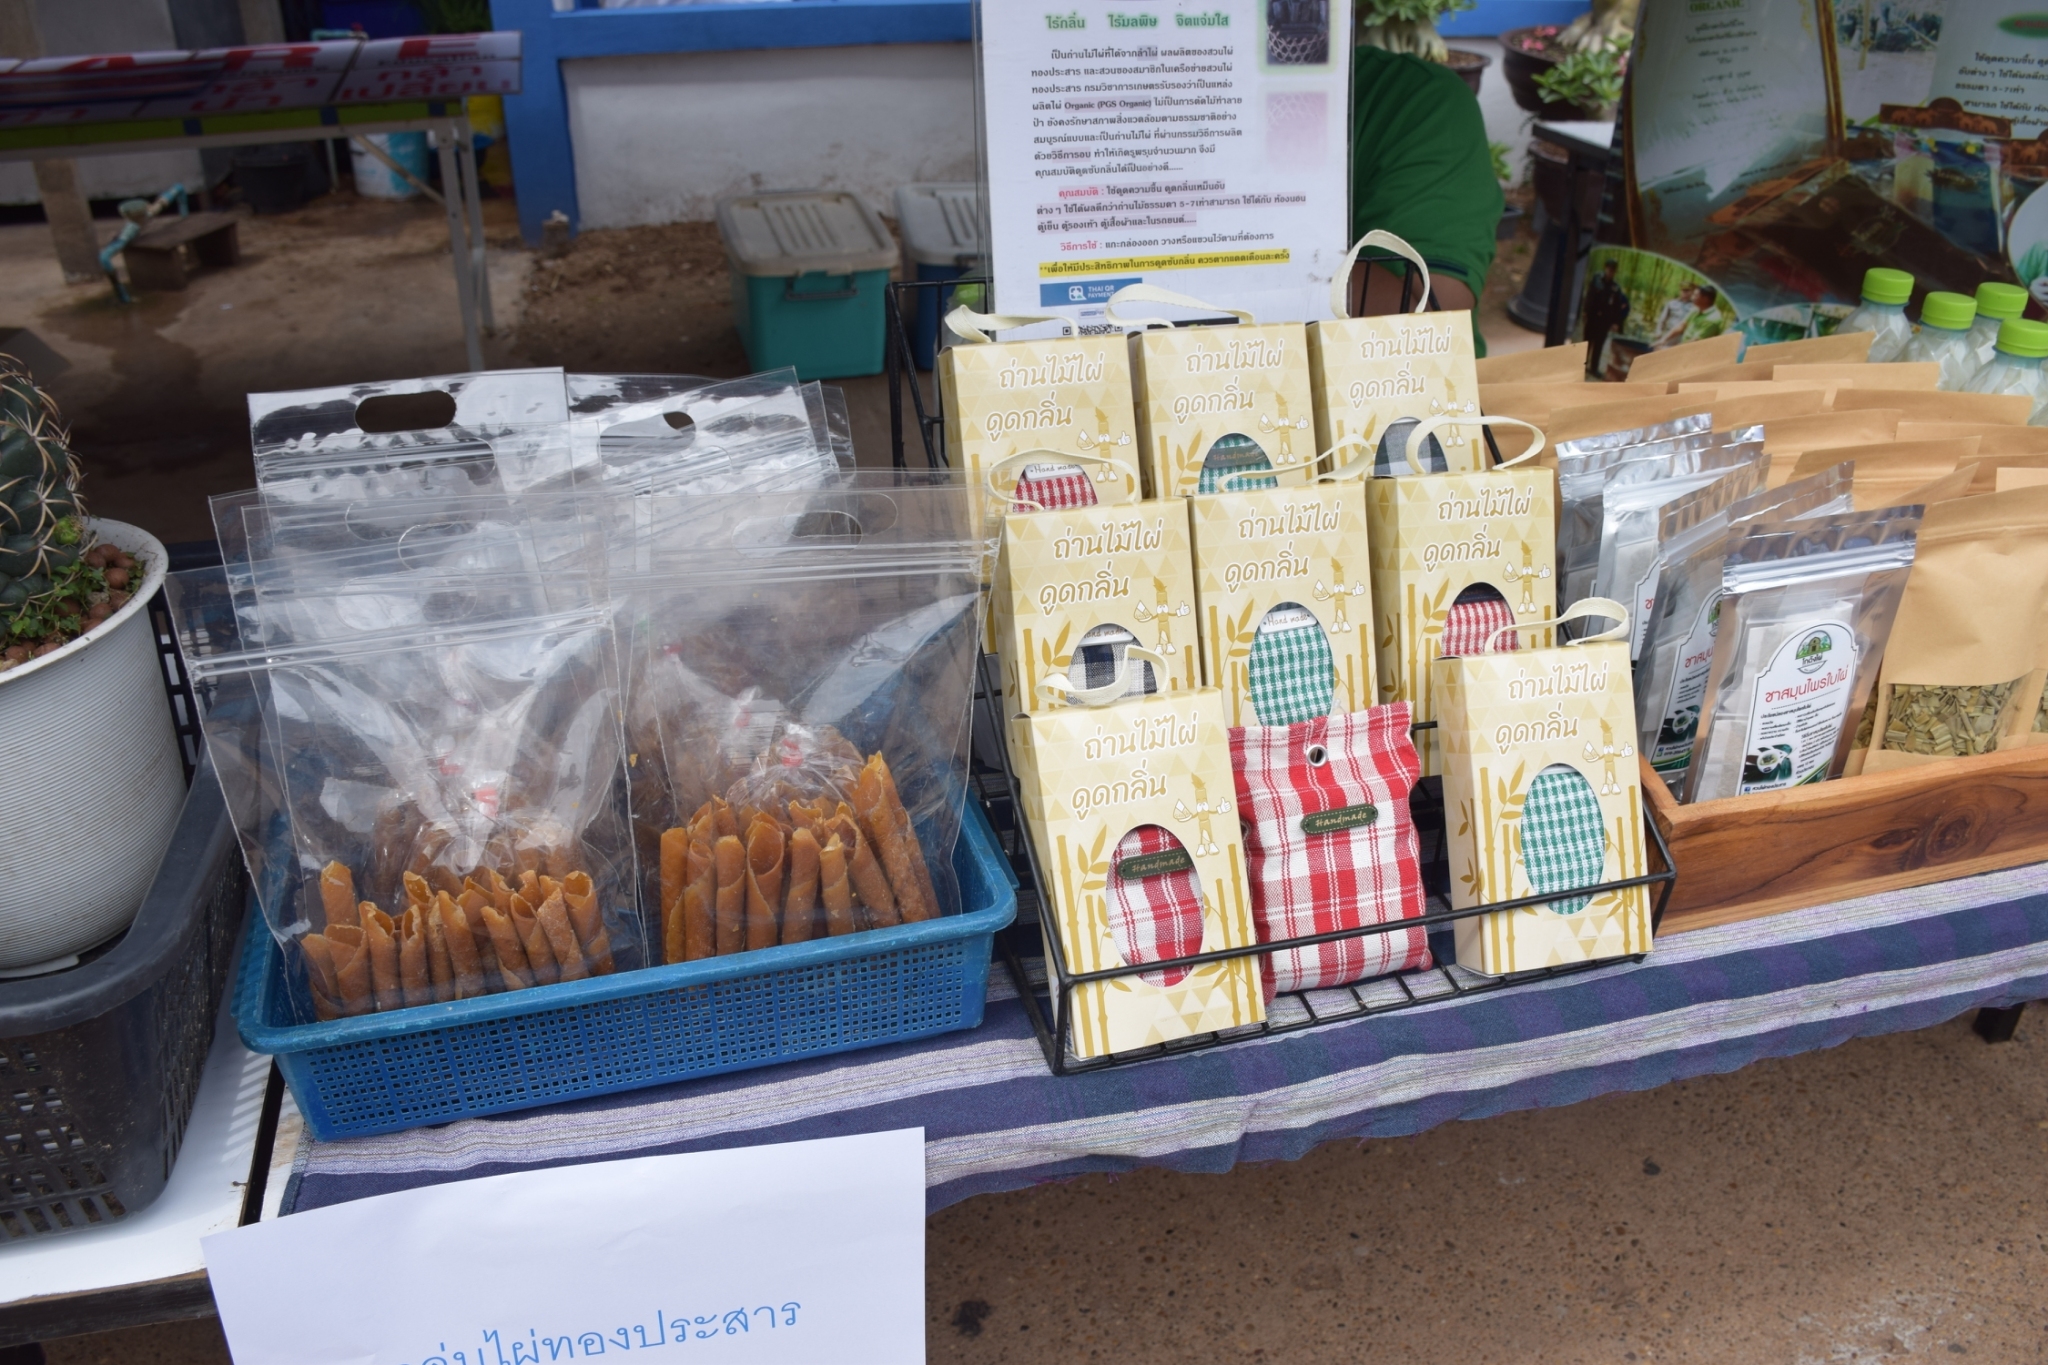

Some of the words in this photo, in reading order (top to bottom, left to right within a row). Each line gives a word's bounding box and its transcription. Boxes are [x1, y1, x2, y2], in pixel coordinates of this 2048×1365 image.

[1047, 12, 1085, 29] ไร้กลิ่น
[1108, 14, 1157, 28] ไร้มลพิษ
[1176, 13, 1229, 27] จิตแจ่มใส
[1031, 67, 1081, 77] ทองประสาร
[1032, 84, 1081, 94] ทองประสาร
[1032, 100, 1062, 111] ผลิตไผ่
[1065, 101, 1095, 111] Organic
[1097, 100, 1117, 110] (PGS
[1120, 99, 1152, 109] Organic)
[1033, 117, 1044, 127] ป่า
[1034, 149, 1092, 160] ด้วยวิธีการอบ
[1199, 145, 1216, 153] จึงมี
[1037, 204, 1053, 214] ต่าง
[1242, 195, 1272, 205] ใช้ได้กับ
[1274, 194, 1306, 203] ห้องนอน
[1059, 186, 1098, 198] คุณสมบัติ
[1107, 182, 1162, 196] ใช้ดูดความชื้น
[1165, 179, 1226, 193] ดูดกลิ่นเหม็นอับ
[1038, 219, 1059, 232] ตู้เย็น
[1062, 218, 1098, 231] ตู้รองเท้า
[1060, 240, 1097, 251] วิธีการใช้
[1105, 237, 1159, 249] แกะกล่องออก
[1087, 291, 1115, 299] PAYMENT
[1088, 285, 1104, 293] THAI
[1104, 284, 1115, 292] QR
[1186, 340, 1283, 372] ถ่านไม้ไผ่
[1361, 327, 1451, 358] ถ่านไม้ไผ่
[1000, 352, 1104, 388] ถ่านไม้ไผ่
[1350, 362, 1424, 408] ดูดกลิ่น
[1174, 376, 1254, 424] ดูดกลิ่น
[986, 391, 1072, 442] ดูดกลิ่น
[1439, 487, 1532, 520] ถ่านไม้ไผ่
[1239, 501, 1340, 538] ถ่านไม้ไผ่
[1054, 519, 1163, 558] ถ่านไม้ไผ่
[1424, 524, 1500, 572] ดูดกลิ่น
[1225, 541, 1309, 594] ดูดกลิ่น
[1040, 561, 1129, 616] ดูดกลิ่น
[1083, 627, 1102, 639] and
[1267, 613, 1288, 626] Hand
[1290, 612, 1308, 622] made
[1508, 662, 1607, 699] ถ่านไม้ไผ่
[1765, 664, 1849, 703] ชาสมุนไพรใบไผ่
[1085, 712, 1197, 759] ถ่านไม้ไผ่
[1496, 702, 1578, 754] ดูดกลิ่น
[1072, 759, 1167, 821] ดูดกลิ่น
[1315, 811, 1368, 827] Handmade
[1131, 856, 1186, 873] Handmade
